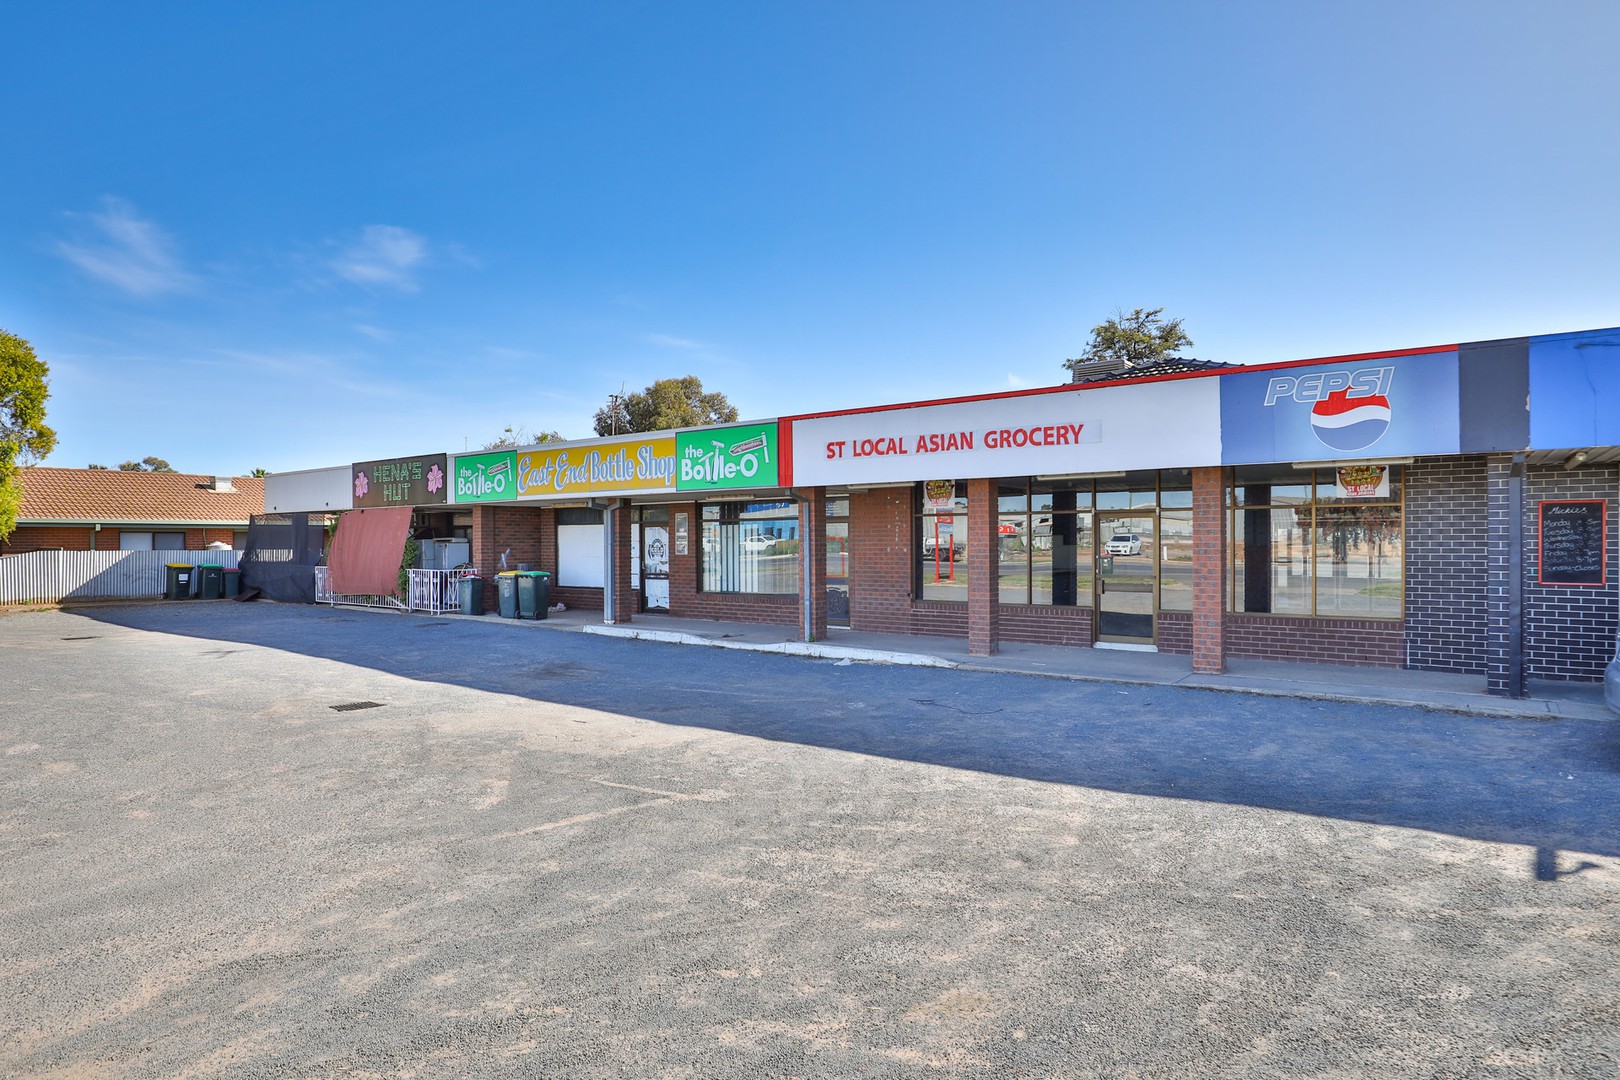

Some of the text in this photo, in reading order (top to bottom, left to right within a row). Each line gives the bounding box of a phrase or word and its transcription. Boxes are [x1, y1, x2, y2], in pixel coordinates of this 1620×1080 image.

[1264, 366, 1395, 406] PEPSI
[826, 424, 1085, 459] ST LOCAL ASIAN GROCERY
[685, 444, 704, 458] the
[373, 461, 422, 483] HENA'S
[460, 466, 472, 477] the
[517, 445, 676, 493] East End Bottle Shop
[383, 482, 411, 501] HUT
[1356, 484, 1374, 492] LOCAL
[1543, 519, 1571, 529] Monday
[1543, 527, 1574, 536] Tuesday
[1543, 541, 1575, 550] Thursday
[1544, 549, 1568, 557] Friday
